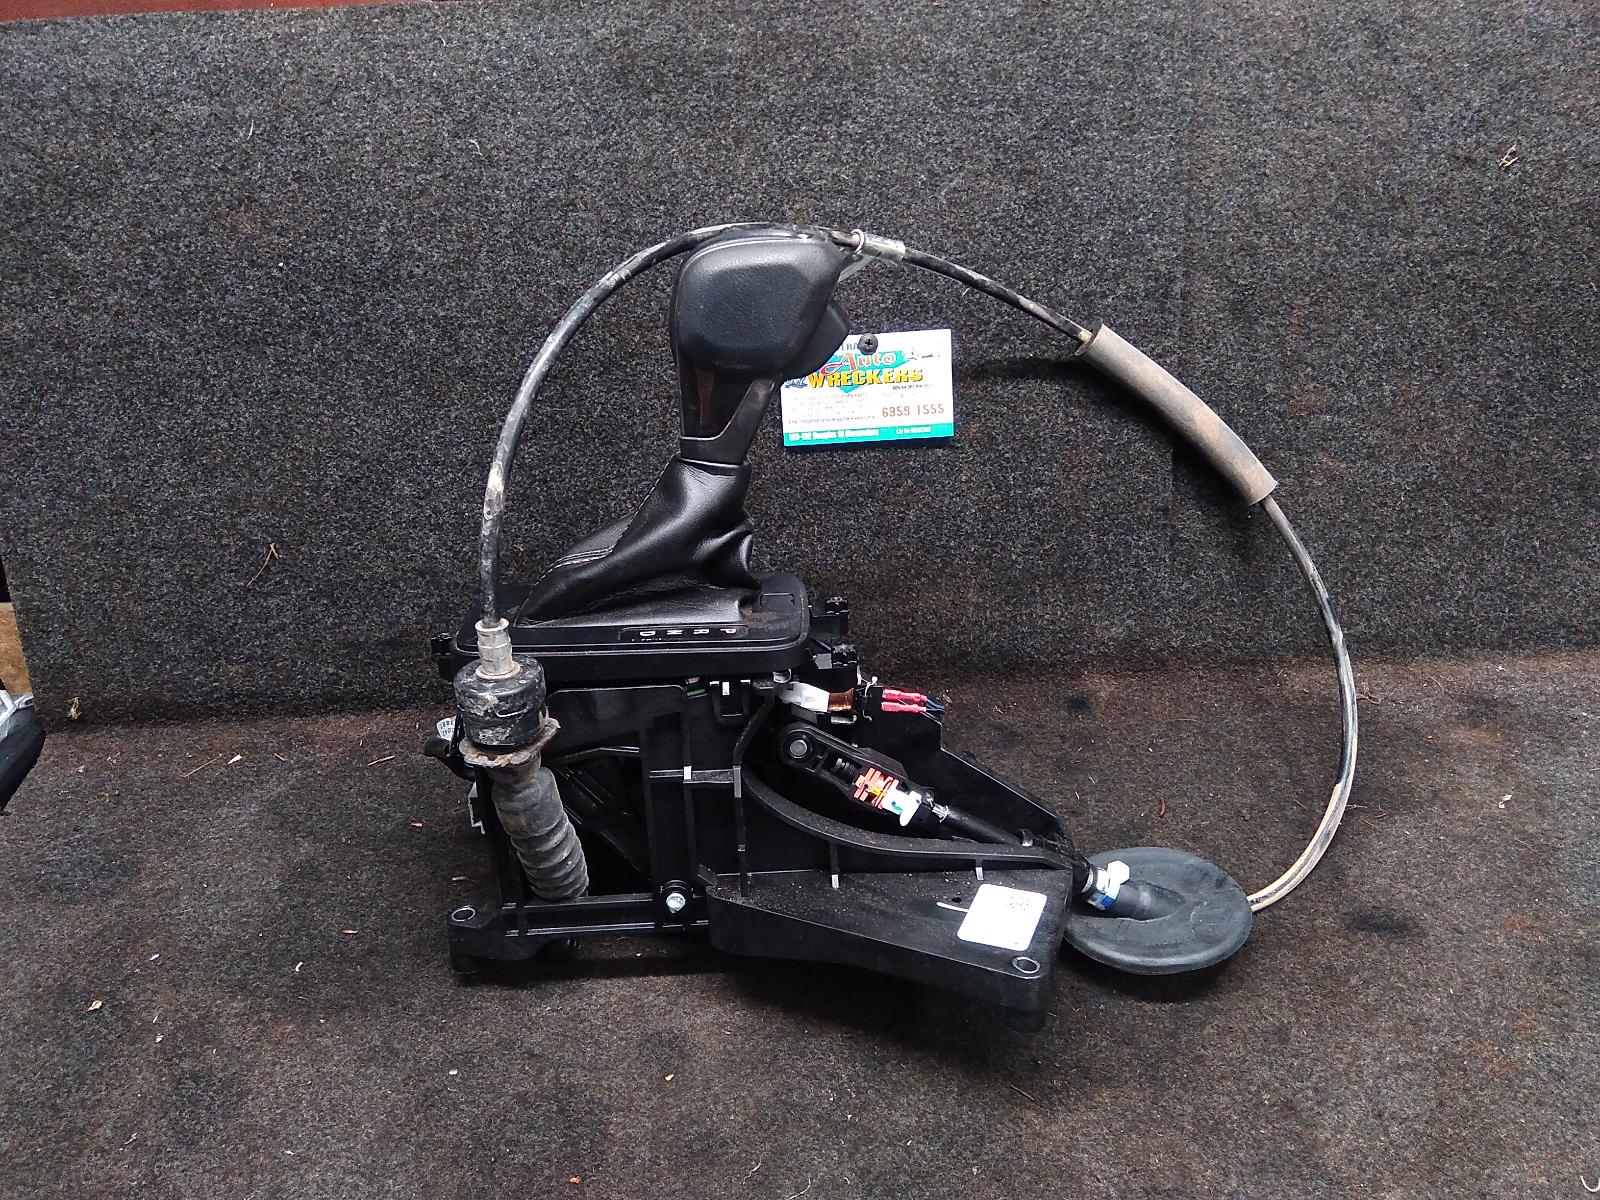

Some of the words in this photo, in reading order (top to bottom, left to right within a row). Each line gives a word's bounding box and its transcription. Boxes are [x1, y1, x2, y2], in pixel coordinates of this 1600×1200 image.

[820, 352, 896, 376] Auto
[807, 367, 924, 389] WRECKERS
[882, 405, 910, 418] 6959
[917, 403, 945, 416] 1555
